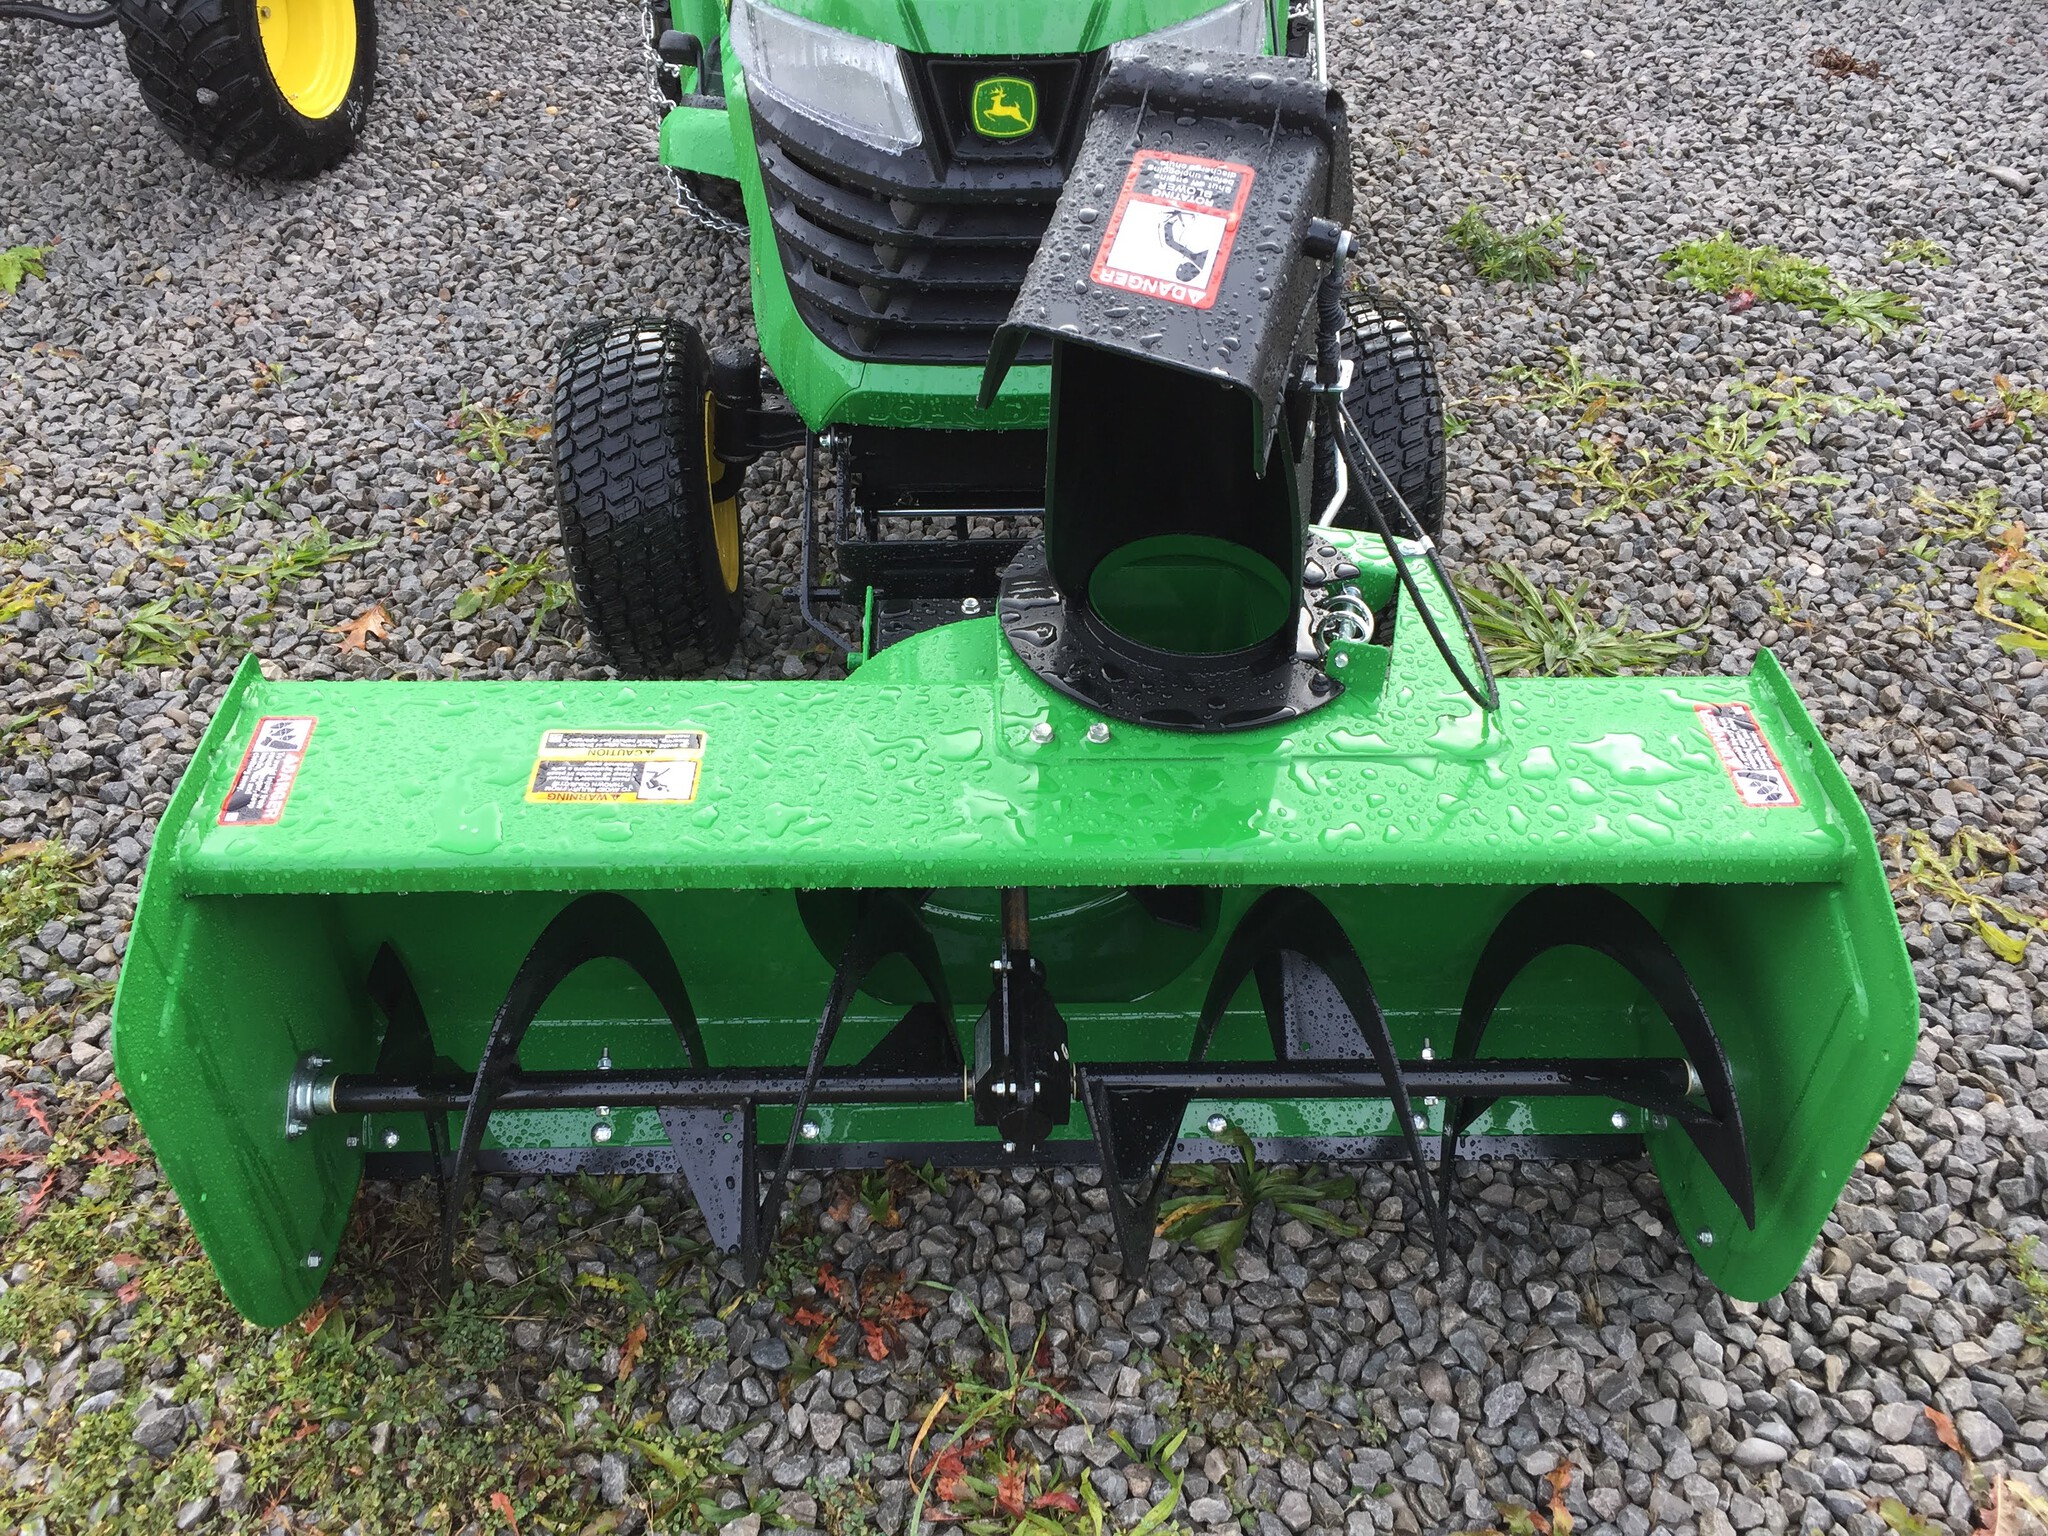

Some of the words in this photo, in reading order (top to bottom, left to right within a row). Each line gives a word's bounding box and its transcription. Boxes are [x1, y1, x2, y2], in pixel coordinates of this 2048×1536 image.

[1147, 164, 1201, 179] unclogging
[1154, 174, 1188, 184] engine
[1204, 175, 1234, 186] before
[1158, 182, 1213, 198] BLOWER
[1208, 183, 1231, 194] Shut
[1152, 188, 1214, 207] ROTATING
[1100, 269, 1186, 300] DANGER
[547, 793, 607, 801] WARNING
